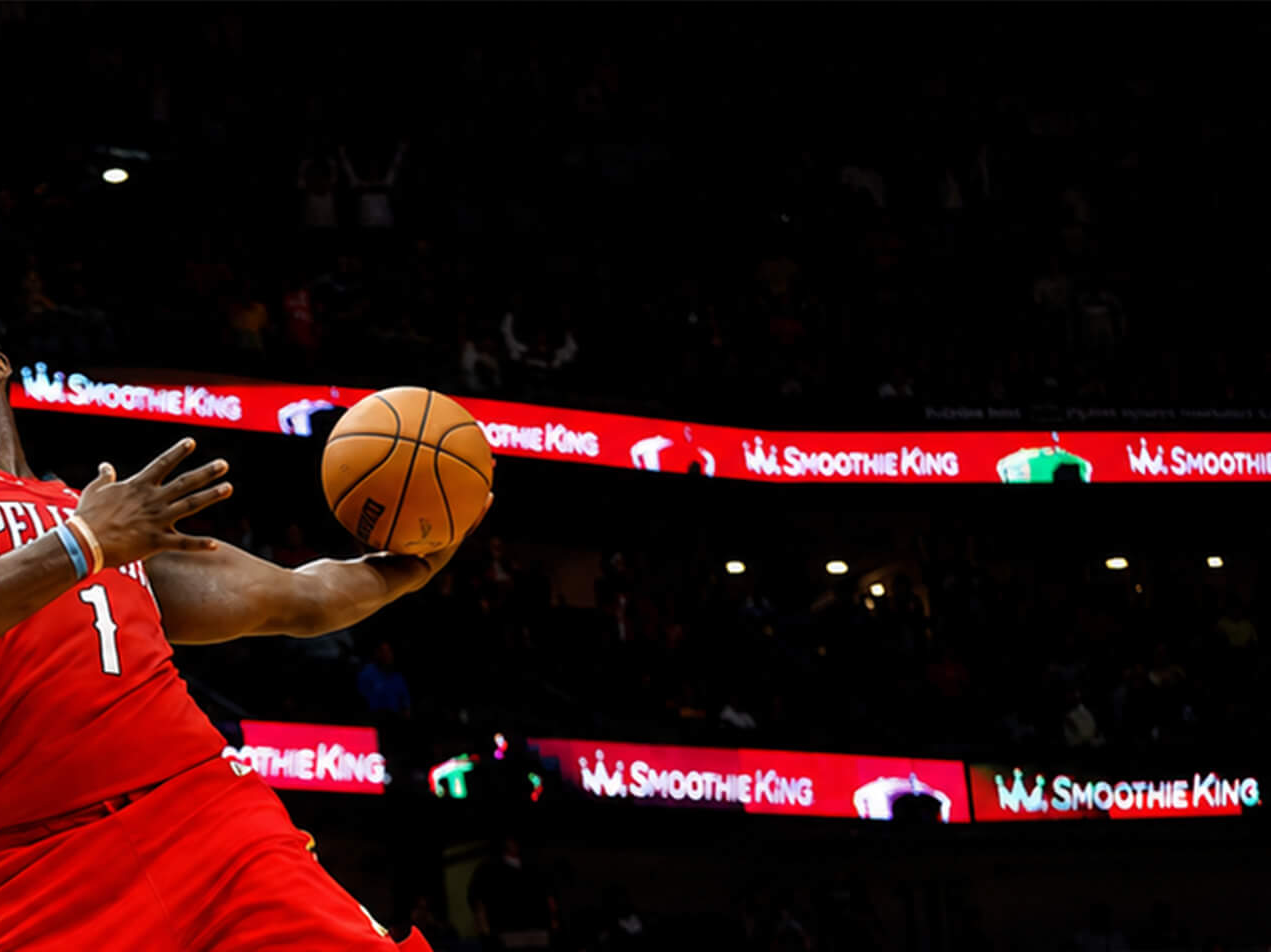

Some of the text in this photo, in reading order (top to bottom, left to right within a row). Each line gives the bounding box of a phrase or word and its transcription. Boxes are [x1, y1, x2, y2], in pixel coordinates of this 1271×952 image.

[67, 373, 241, 420] SMOOTHIE KING
[478, 420, 599, 457] OTHIE KING
[783, 445, 959, 477] SMOOTHIE KING
[79, 584, 121, 676] 1
[316, 742, 385, 784] KING
[630, 760, 813, 806] SMOOTHIE KING
[1051, 772, 1260, 811] SMOOTHIE KING
